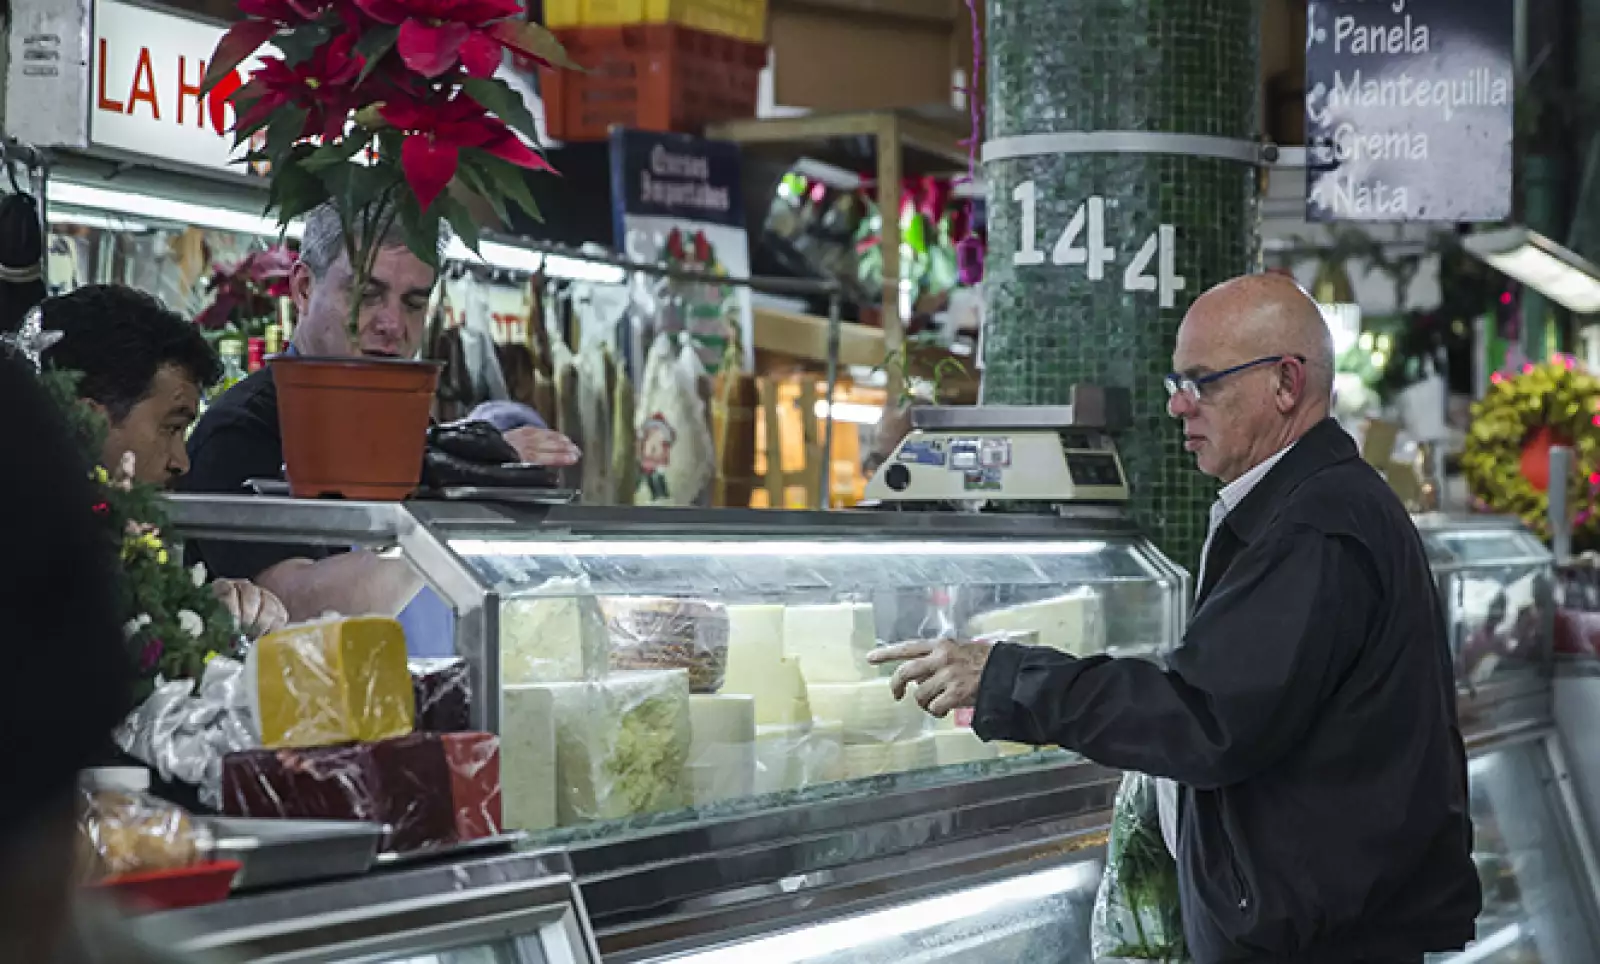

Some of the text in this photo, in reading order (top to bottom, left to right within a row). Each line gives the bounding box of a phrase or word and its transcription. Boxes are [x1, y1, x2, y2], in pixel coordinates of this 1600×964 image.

[1334, 15, 1430, 54] Panela
[99, 38, 160, 120] LA
[1334, 68, 1507, 121] Mantequilla
[1334, 123, 1428, 160] Crema
[1334, 174, 1409, 214] Nata
